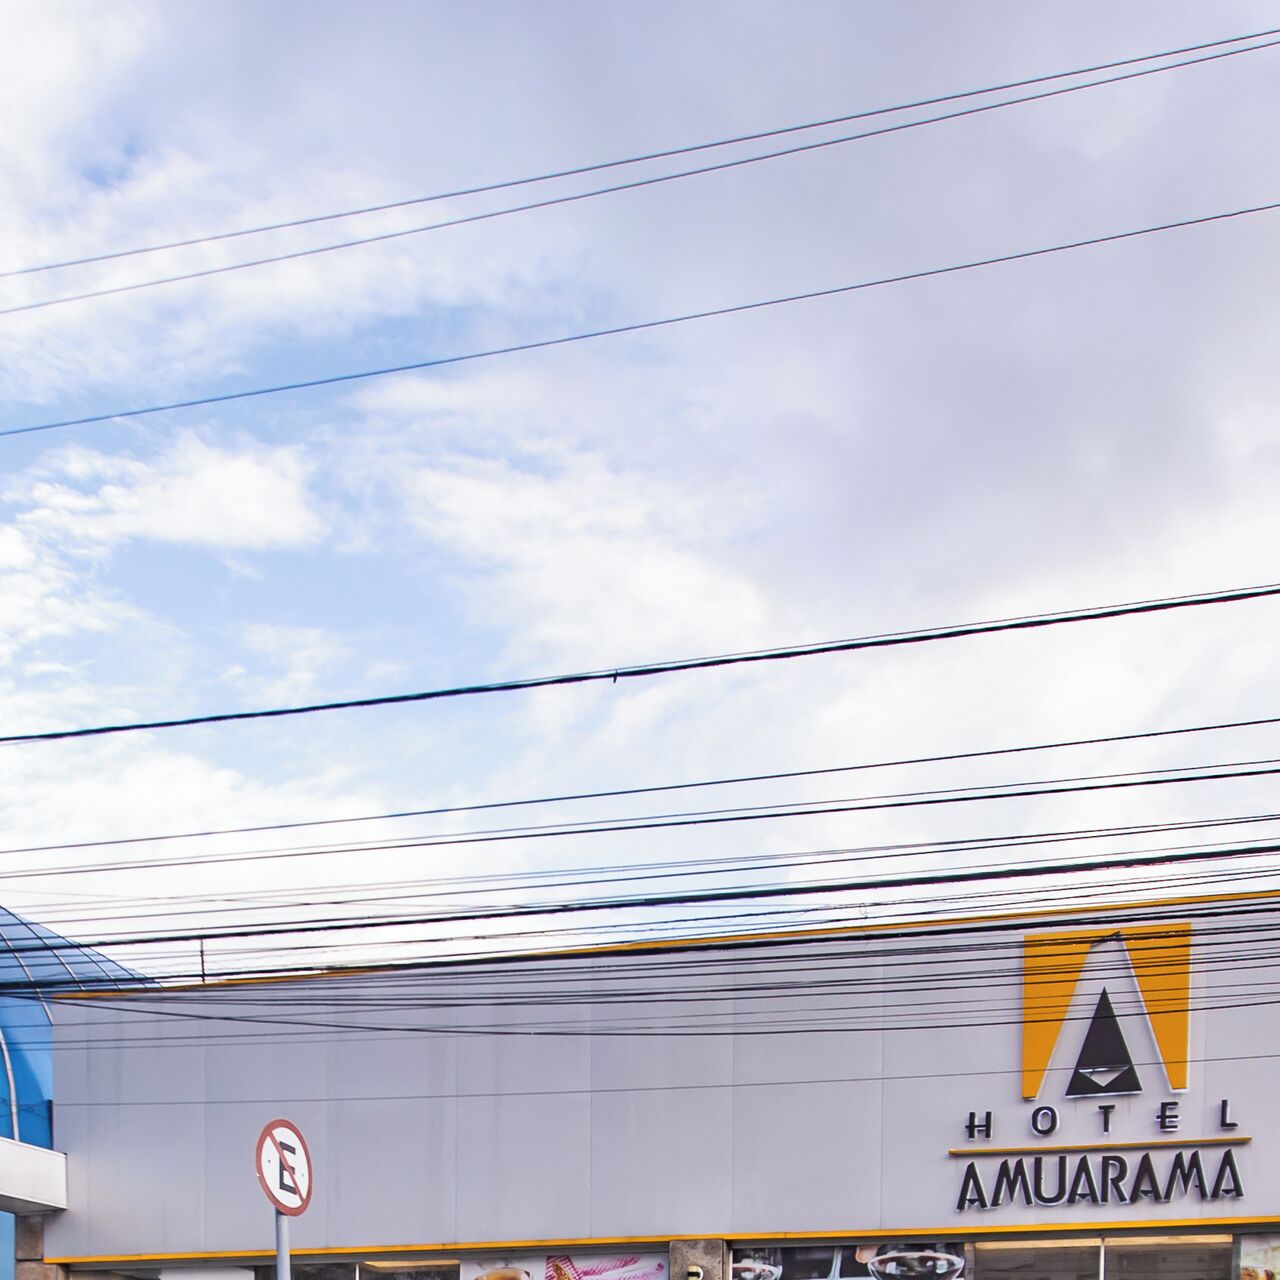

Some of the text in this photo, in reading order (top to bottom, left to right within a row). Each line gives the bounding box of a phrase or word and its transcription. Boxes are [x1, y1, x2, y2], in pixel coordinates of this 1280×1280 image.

[965, 1099, 1239, 1138] HOTEL
[279, 1140, 298, 1195] E
[956, 1147, 1245, 1210] AMUARAMA
